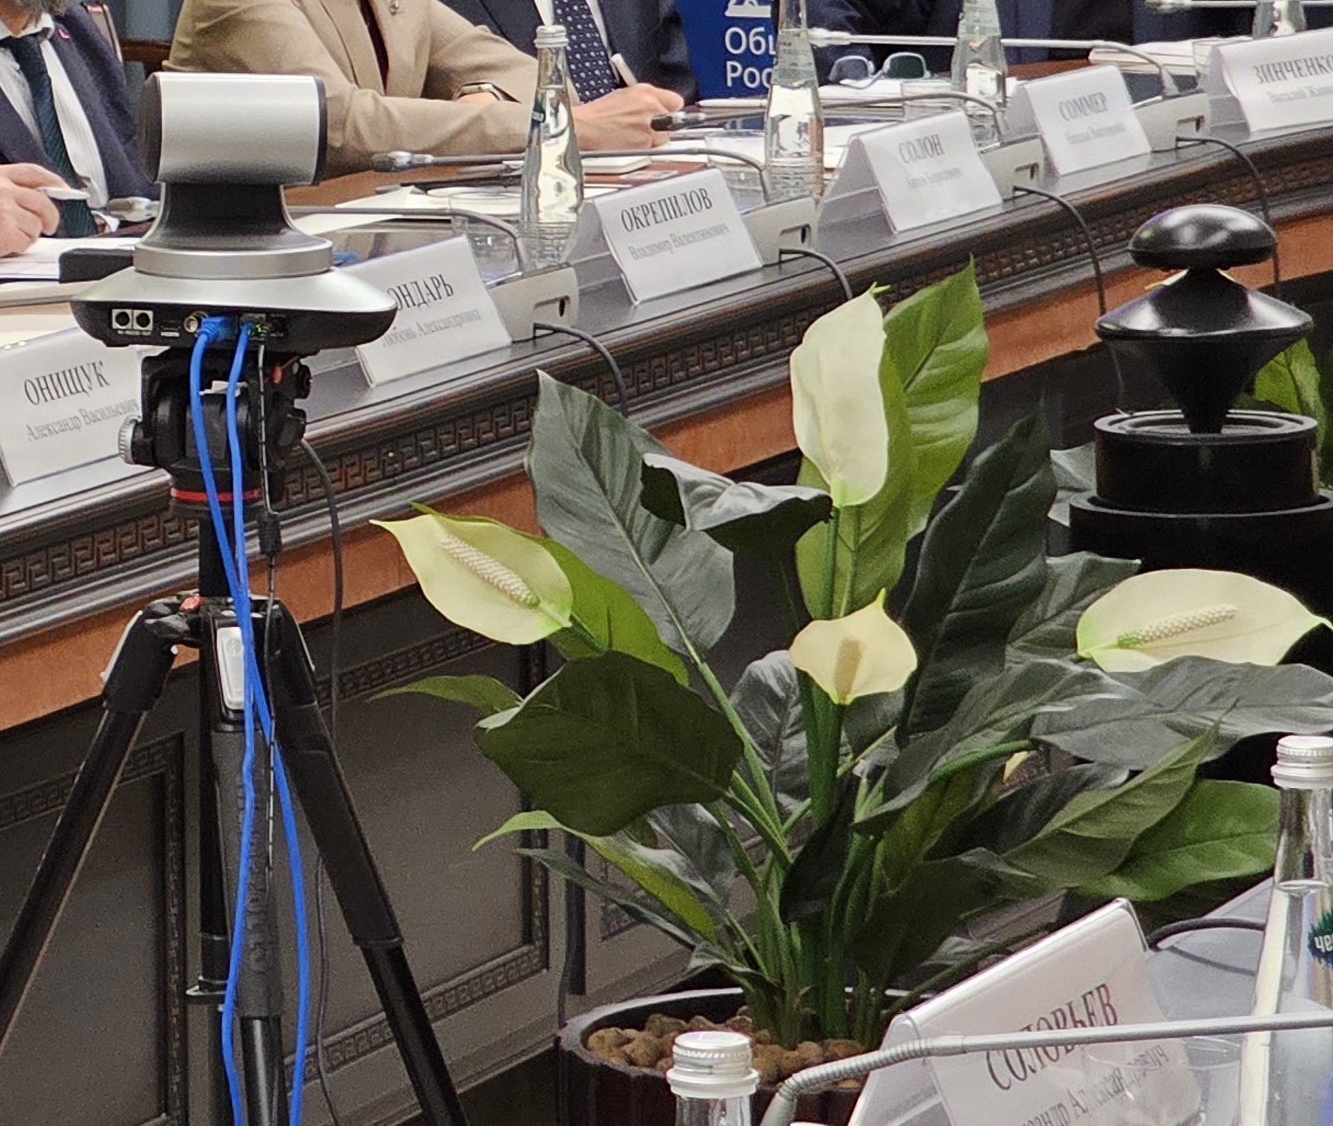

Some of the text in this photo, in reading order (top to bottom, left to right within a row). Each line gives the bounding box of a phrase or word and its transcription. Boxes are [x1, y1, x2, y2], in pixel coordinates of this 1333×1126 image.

[620, 188, 713, 233] ОКРЕПИЛОВ
[386, 274, 454, 311] ОНДАРЬ
[23, 360, 110, 406] ОНИЩУК
[25, 414, 82, 442] Александр
